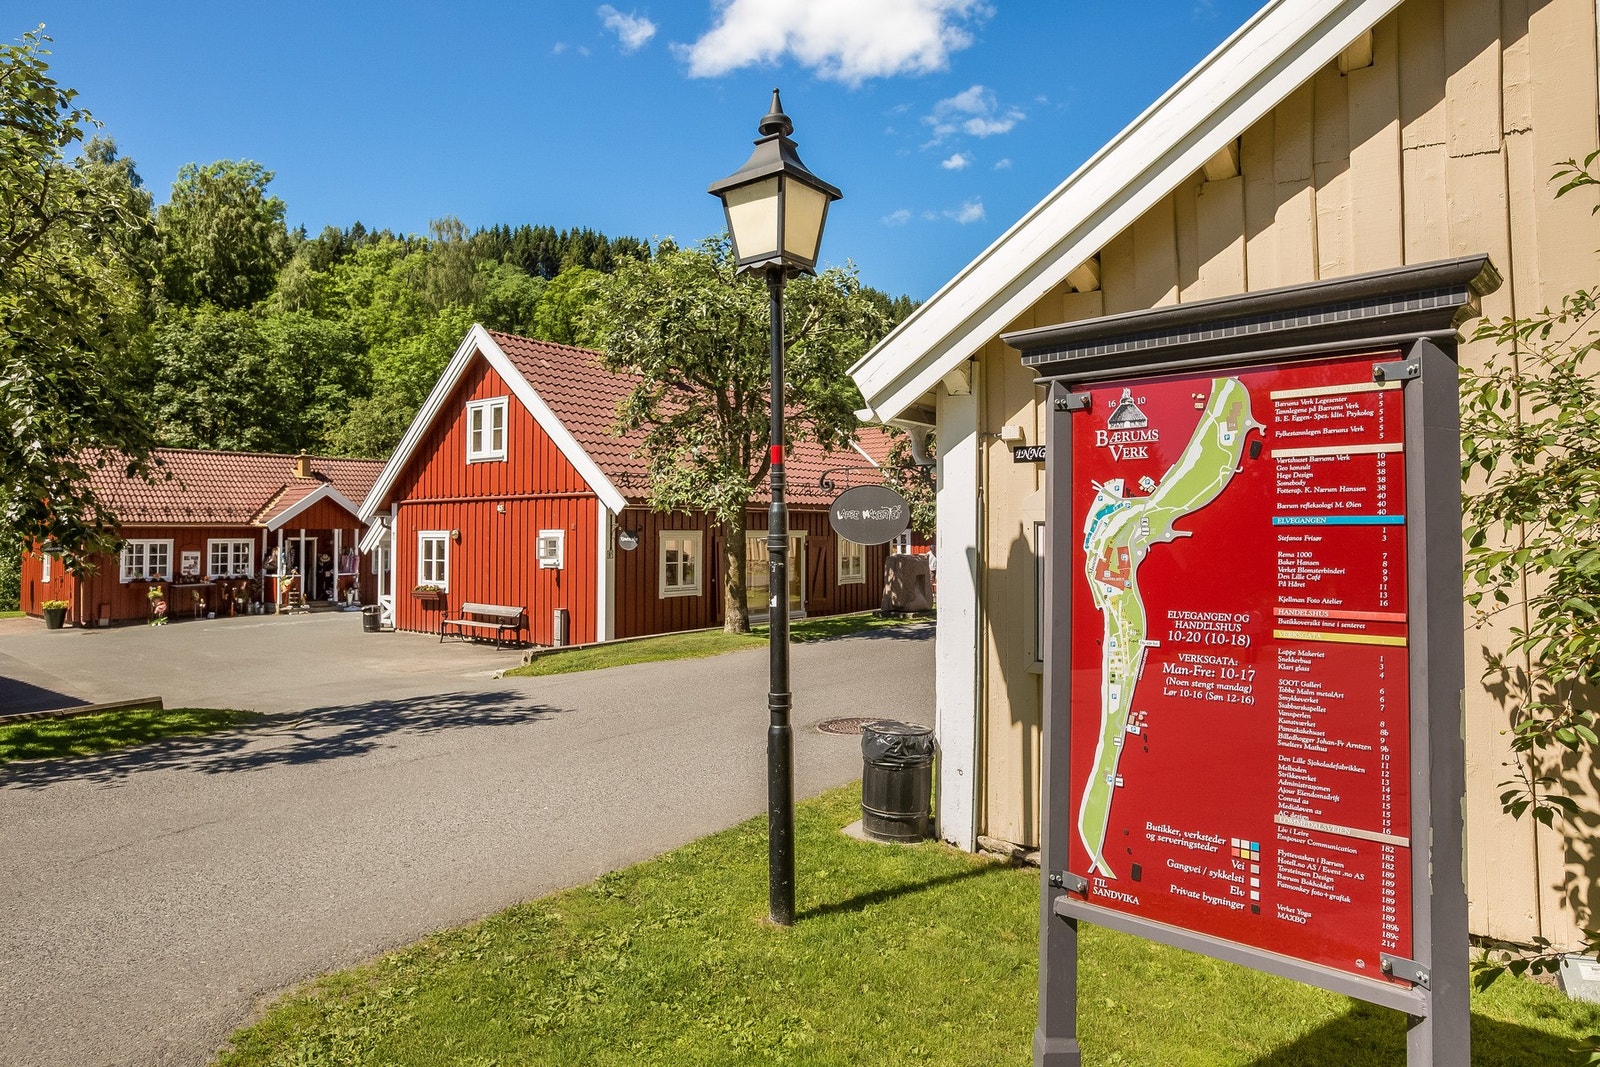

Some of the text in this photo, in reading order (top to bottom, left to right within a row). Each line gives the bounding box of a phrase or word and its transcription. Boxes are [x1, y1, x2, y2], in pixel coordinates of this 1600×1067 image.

[1108, 400, 1116, 408] 16
[1137, 396, 1146, 405] 10
[1315, 397, 1347, 405] Legesenter
[1308, 405, 1317, 413] på
[1318, 404, 1343, 412] Bærums
[1346, 409, 1374, 417] Psykolog
[1095, 428, 1159, 447] BÆRUMS
[1275, 429, 1321, 438] Fylkestannlegen
[1108, 445, 1149, 462] VERK
[1276, 472, 1291, 480] Hege
[1300, 502, 1333, 510] refleksologi
[1167, 610, 1250, 623] ELVEGANGEN OG
[1278, 609, 1329, 617] HANDELSHUS
[1175, 620, 1242, 632] HANDELSHUS
[1278, 618, 1320, 627] Butikkoversikt
[1168, 630, 1251, 648] 10-20 (10-18)
[1278, 648, 1325, 658] Lappe Makeriet
[1178, 653, 1238, 666] VERKSGATA:
[1162, 662, 1216, 677] Man-Fre:
[1220, 667, 1256, 682] 10-17
[1278, 663, 1294, 671] Klart
[1166, 676, 1253, 694] (Noen stengt mandag)
[1163, 687, 1255, 706] Lør 10-16 (Søn 12-16)
[1278, 694, 1319, 704] Smykkeverket
[1297, 688, 1314, 696] Malm
[1316, 691, 1344, 699] metalArt
[1278, 733, 1372, 751] Billedhogger Johan-Fr Arntzen
[1304, 744, 1328, 752] Mathus
[1292, 757, 1306, 765] Lille
[1307, 758, 1366, 773] Sjokoladefabrikken
[1278, 771, 1317, 782] Strikkeverket
[1278, 779, 1331, 792] Administrasjonen
[1278, 786, 1295, 795] Ajour
[1146, 821, 1227, 846] Butikker, verksteder
[1277, 825, 1309, 838] Liv Leire
[1146, 833, 1218, 853] og serveringsteder
[1277, 833, 1358, 855] Empower Communication
[1381, 845, 1395, 853] 182
[1231, 859, 1245, 871] Vei
[1321, 858, 1345, 869] Bærum
[1166, 858, 1245, 884] Gangvei sykkelsti
[1306, 861, 1317, 871] AS
[1322, 865, 1341, 876] Event
[1354, 871, 1365, 880] AS
[1382, 871, 1395, 879] 189
[1093, 877, 1108, 888] TIL
[1277, 873, 1335, 891] Bærum Bokholderi
[1312, 872, 1335, 883] Design
[1230, 885, 1246, 897] Elv
[1277, 881, 1310, 895] Fatmonkey
[1093, 886, 1140, 905] SANDVIKA
[1170, 884, 1245, 910] Private bygninger
[1277, 903, 1312, 918] Verket Yoga
[1277, 912, 1307, 925] MAXBO
[1382, 922, 1399, 932] 189b
[1382, 931, 1399, 941] 189c
[1381, 939, 1396, 949] 214
